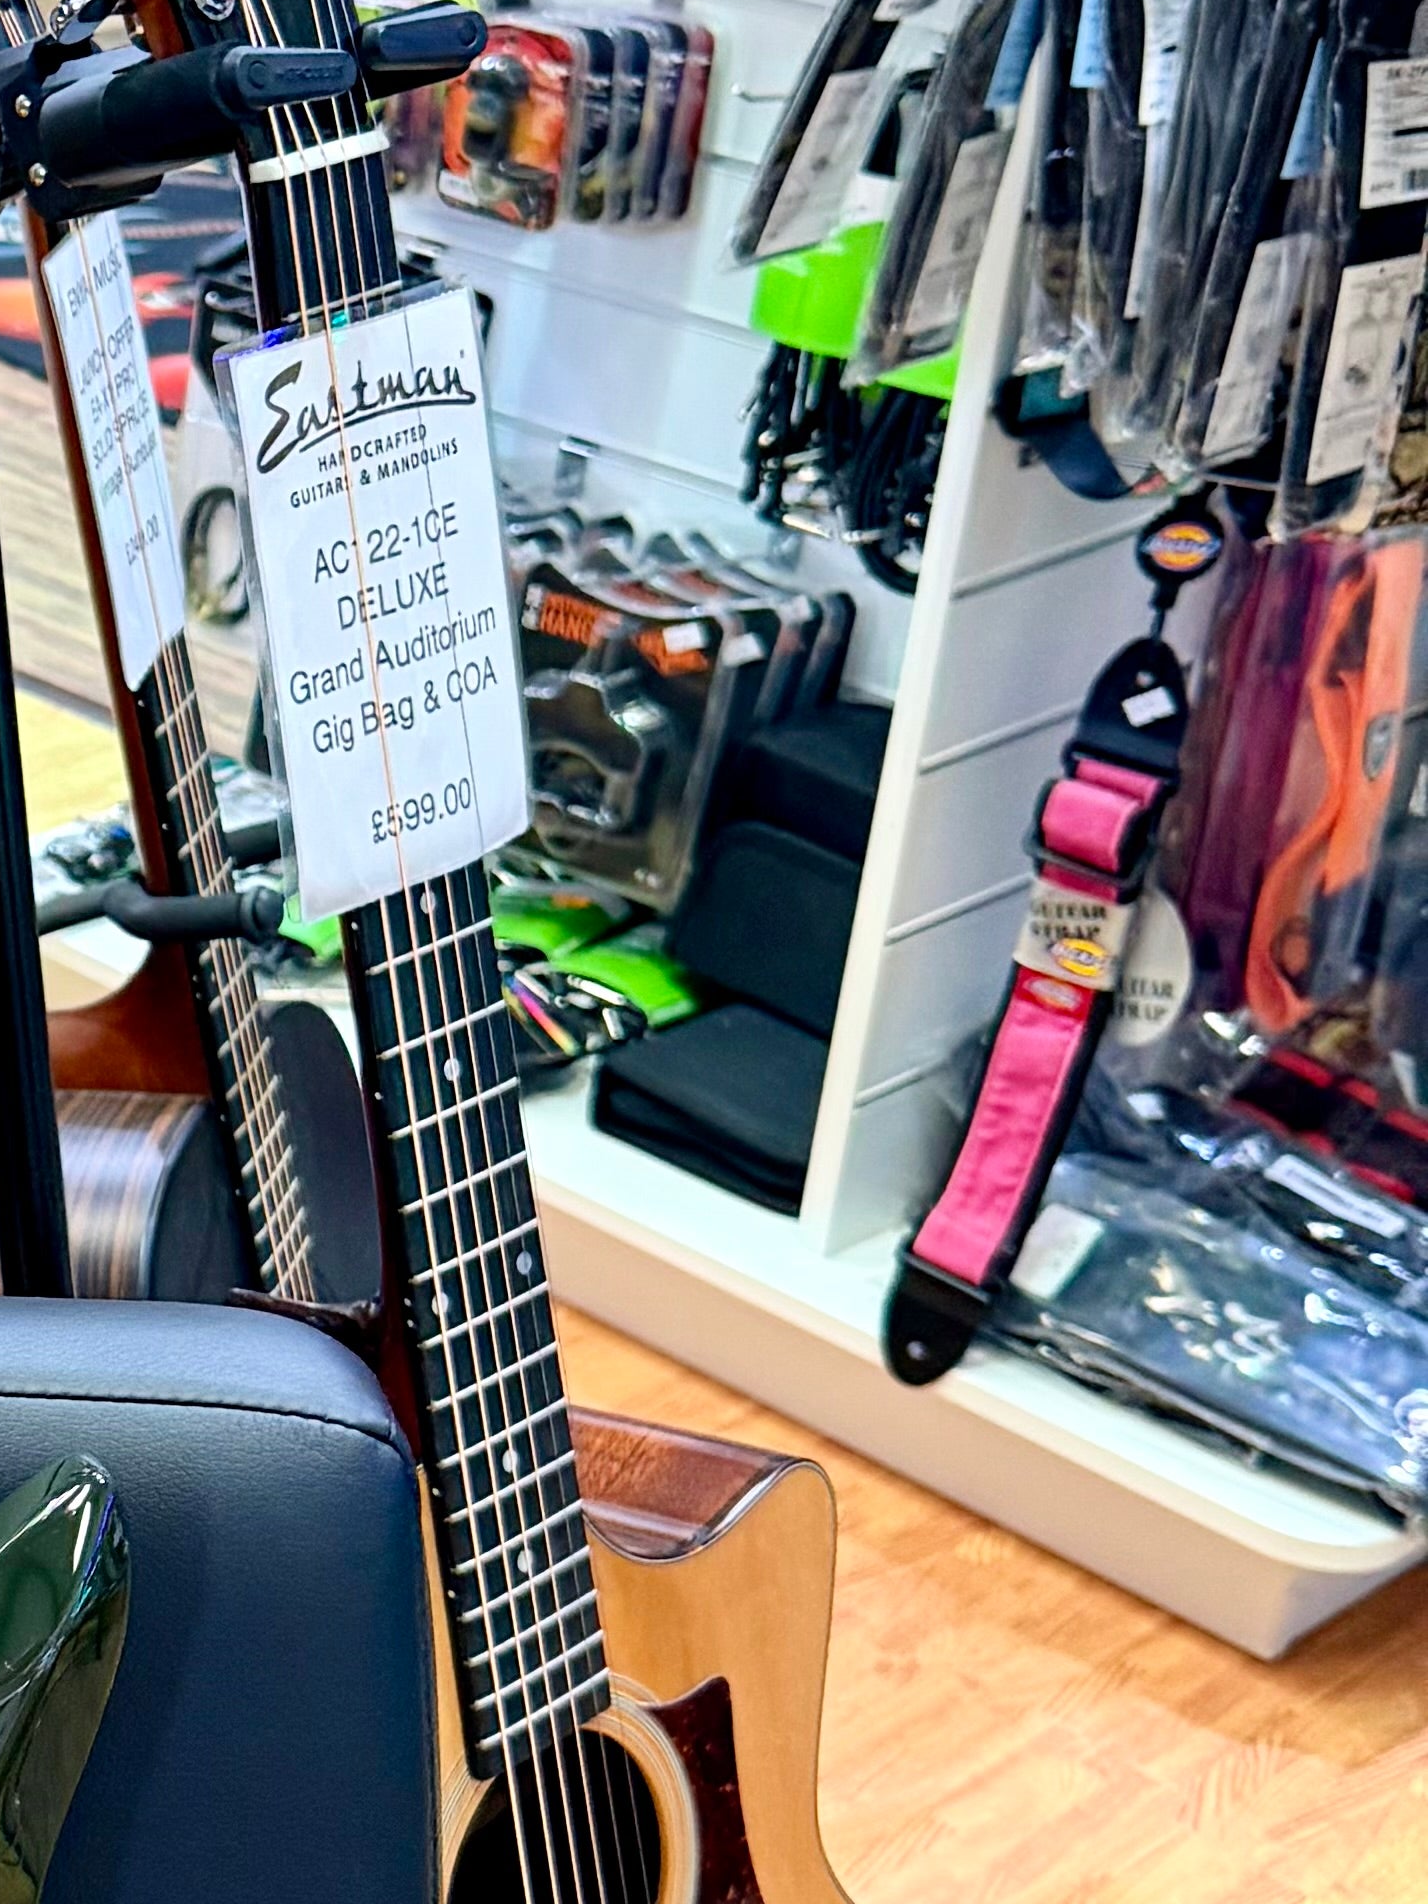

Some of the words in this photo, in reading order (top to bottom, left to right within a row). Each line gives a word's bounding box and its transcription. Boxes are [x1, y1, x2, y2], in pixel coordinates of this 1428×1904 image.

[256, 358, 477, 475] Eastman
[317, 423, 429, 474] HANDCRAFTED
[289, 473, 352, 509] GUITARS
[359, 468, 372, 486] &
[376, 437, 460, 482] MANDOLINS
[313, 501, 460, 585] AC22-1CE
[337, 561, 450, 631] DELUXE
[289, 647, 365, 705] Grand
[374, 605, 498, 672] Auditorium
[312, 714, 355, 754] Gig
[360, 695, 415, 736] Bag
[423, 679, 441, 714] &
[446, 655, 498, 703] COA
[370, 776, 472, 845] £599.00
